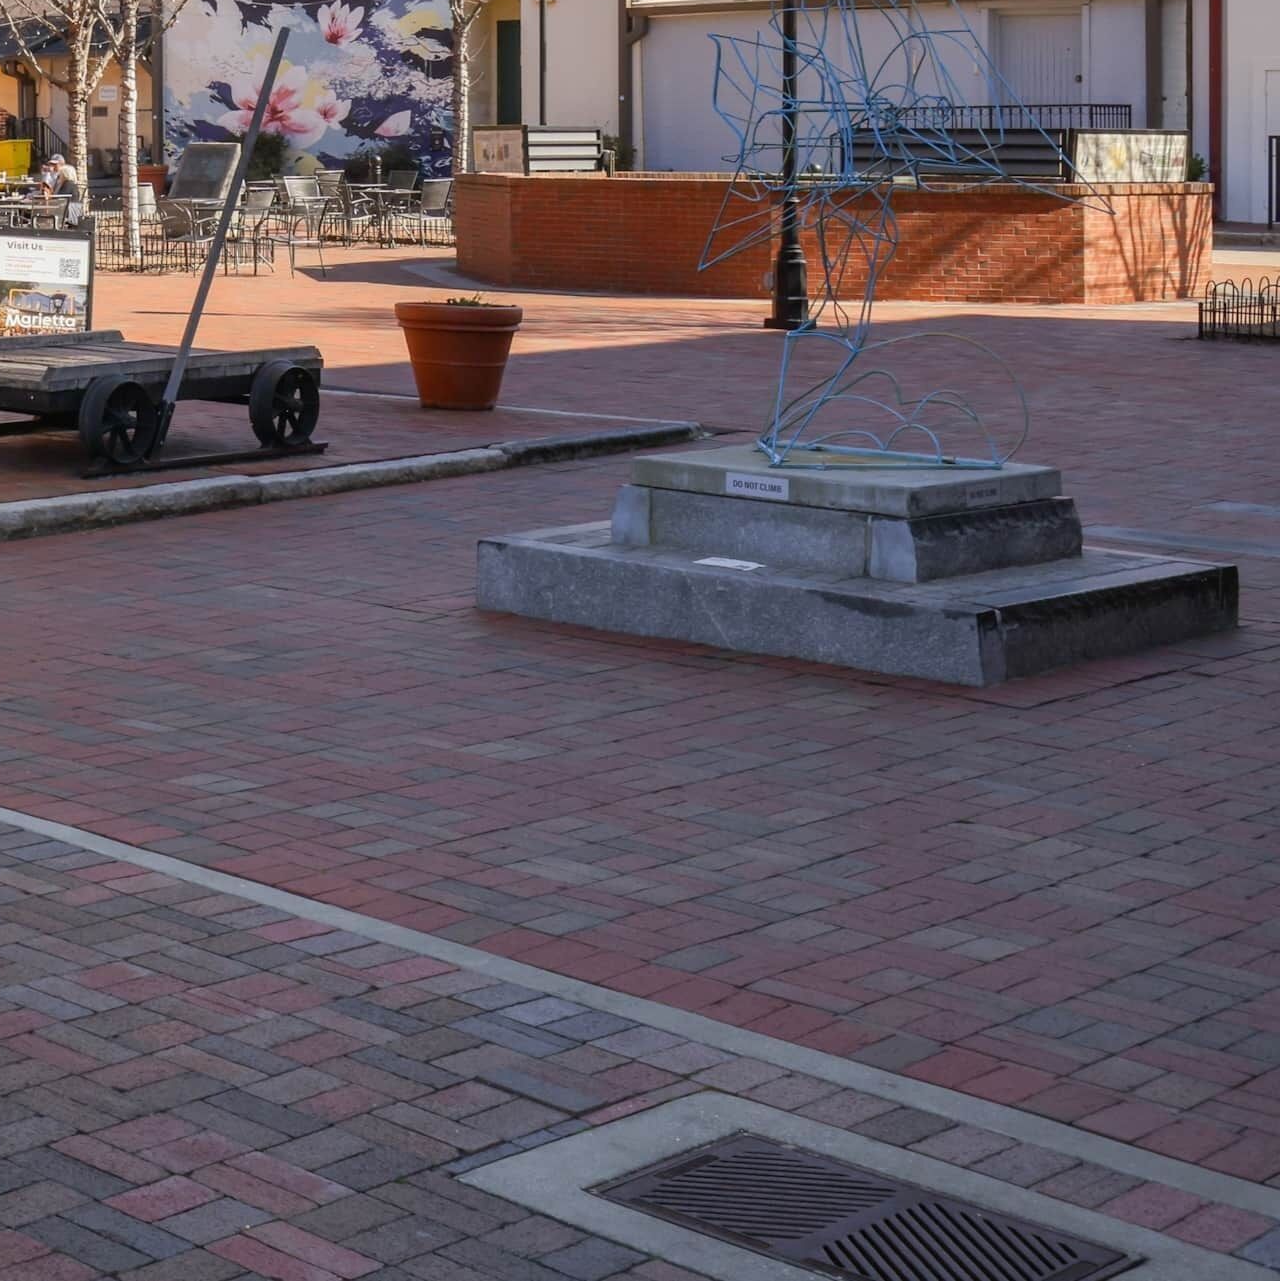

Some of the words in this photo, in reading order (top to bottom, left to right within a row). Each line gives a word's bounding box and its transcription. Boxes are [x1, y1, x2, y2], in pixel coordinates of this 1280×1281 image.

[7, 241, 29, 250] Visit
[31, 242, 44, 251] Us
[5, 312, 76, 328] Marietta
[733, 480, 743, 488] DO
[745, 482, 758, 490] NOT
[760, 484, 782, 493] CLIMB
